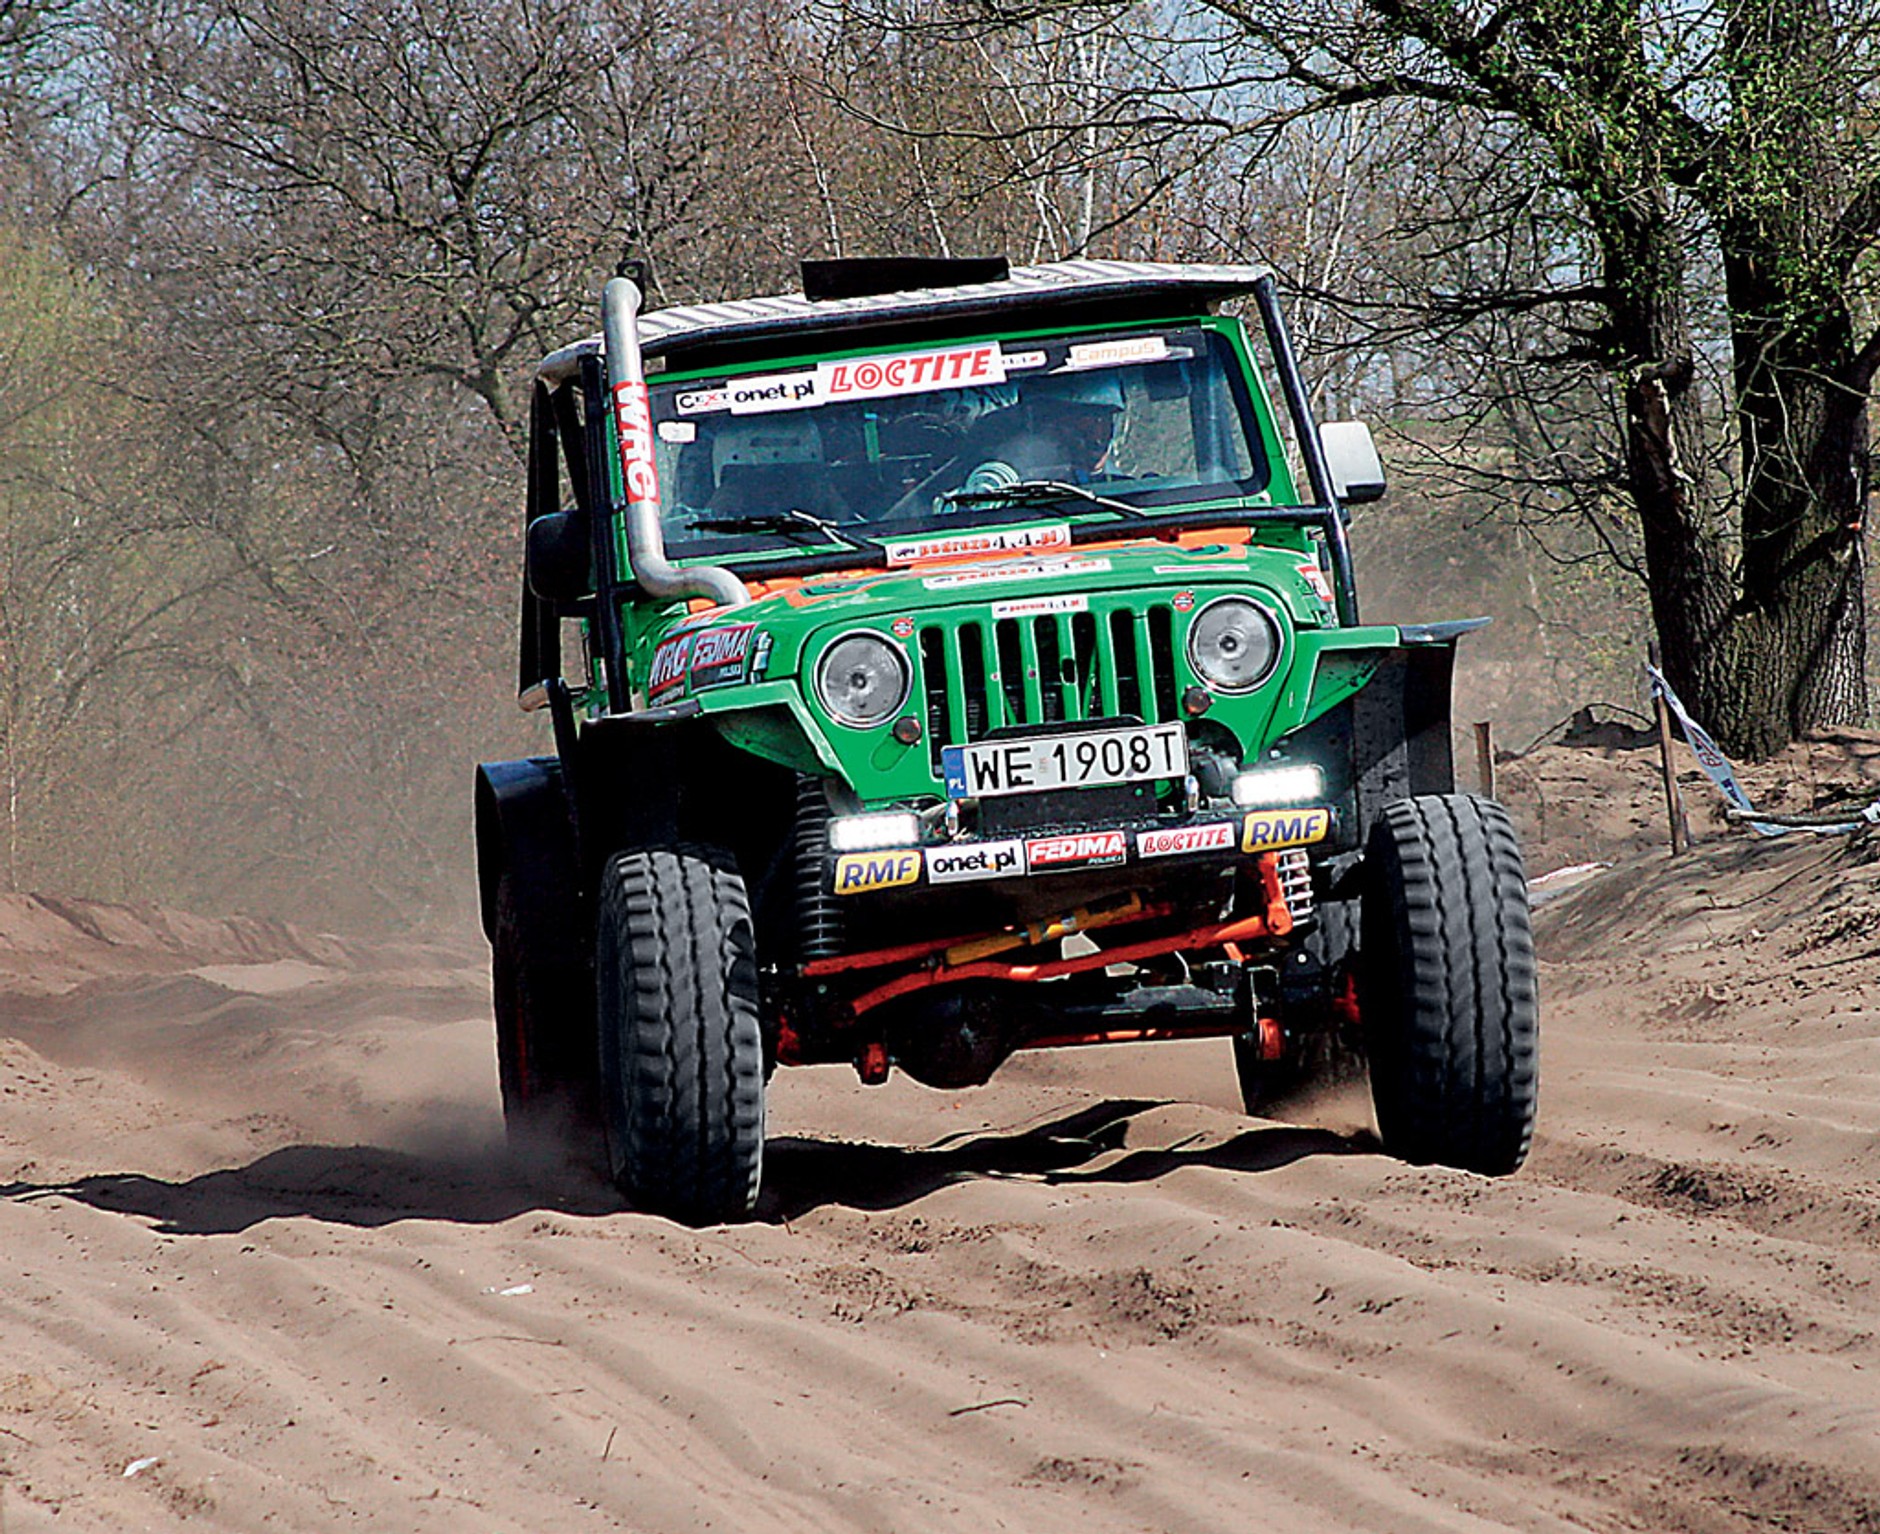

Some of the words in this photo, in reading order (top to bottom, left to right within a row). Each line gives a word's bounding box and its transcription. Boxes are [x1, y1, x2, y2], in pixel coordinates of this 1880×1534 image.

[829, 349, 992, 393] LOCTITE
[734, 379, 815, 403] onet.pl
[616, 384, 657, 499] WRC
[970, 746, 1034, 791] WE
[1052, 730, 1178, 782] 1908T
[948, 778, 965, 790] PL
[1144, 827, 1228, 853] LOCTITE
[1250, 815, 1321, 845] RMF
[933, 847, 1017, 873] onet.pl
[1028, 834, 1123, 864] FEDIMA
[842, 856, 914, 889] RMF
